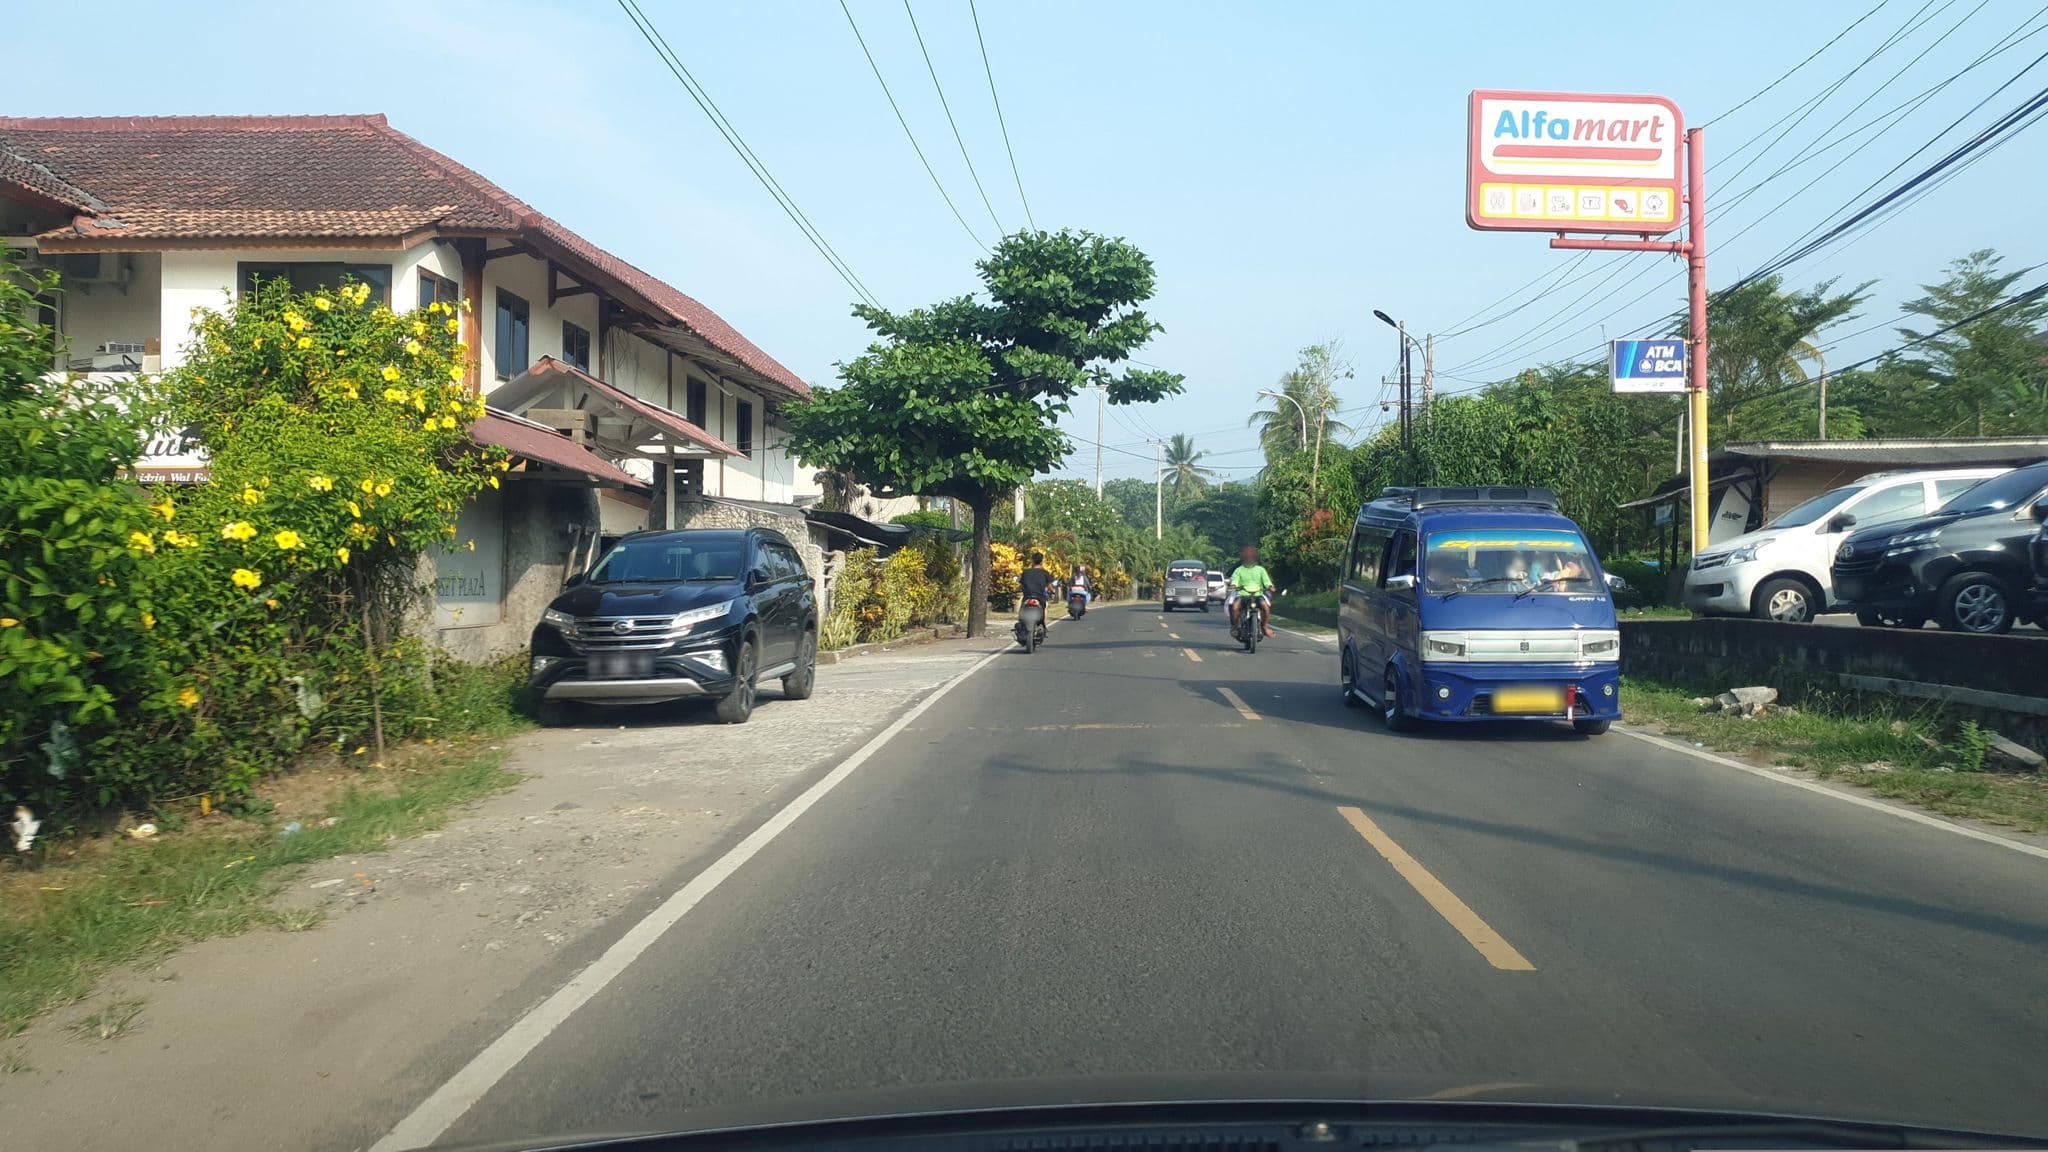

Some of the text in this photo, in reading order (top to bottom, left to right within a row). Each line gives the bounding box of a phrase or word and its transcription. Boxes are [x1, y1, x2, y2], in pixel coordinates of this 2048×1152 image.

[1494, 110, 1664, 142] Alfamart
[1645, 345, 1675, 358] ATM
[1655, 360, 1682, 372] BCA
